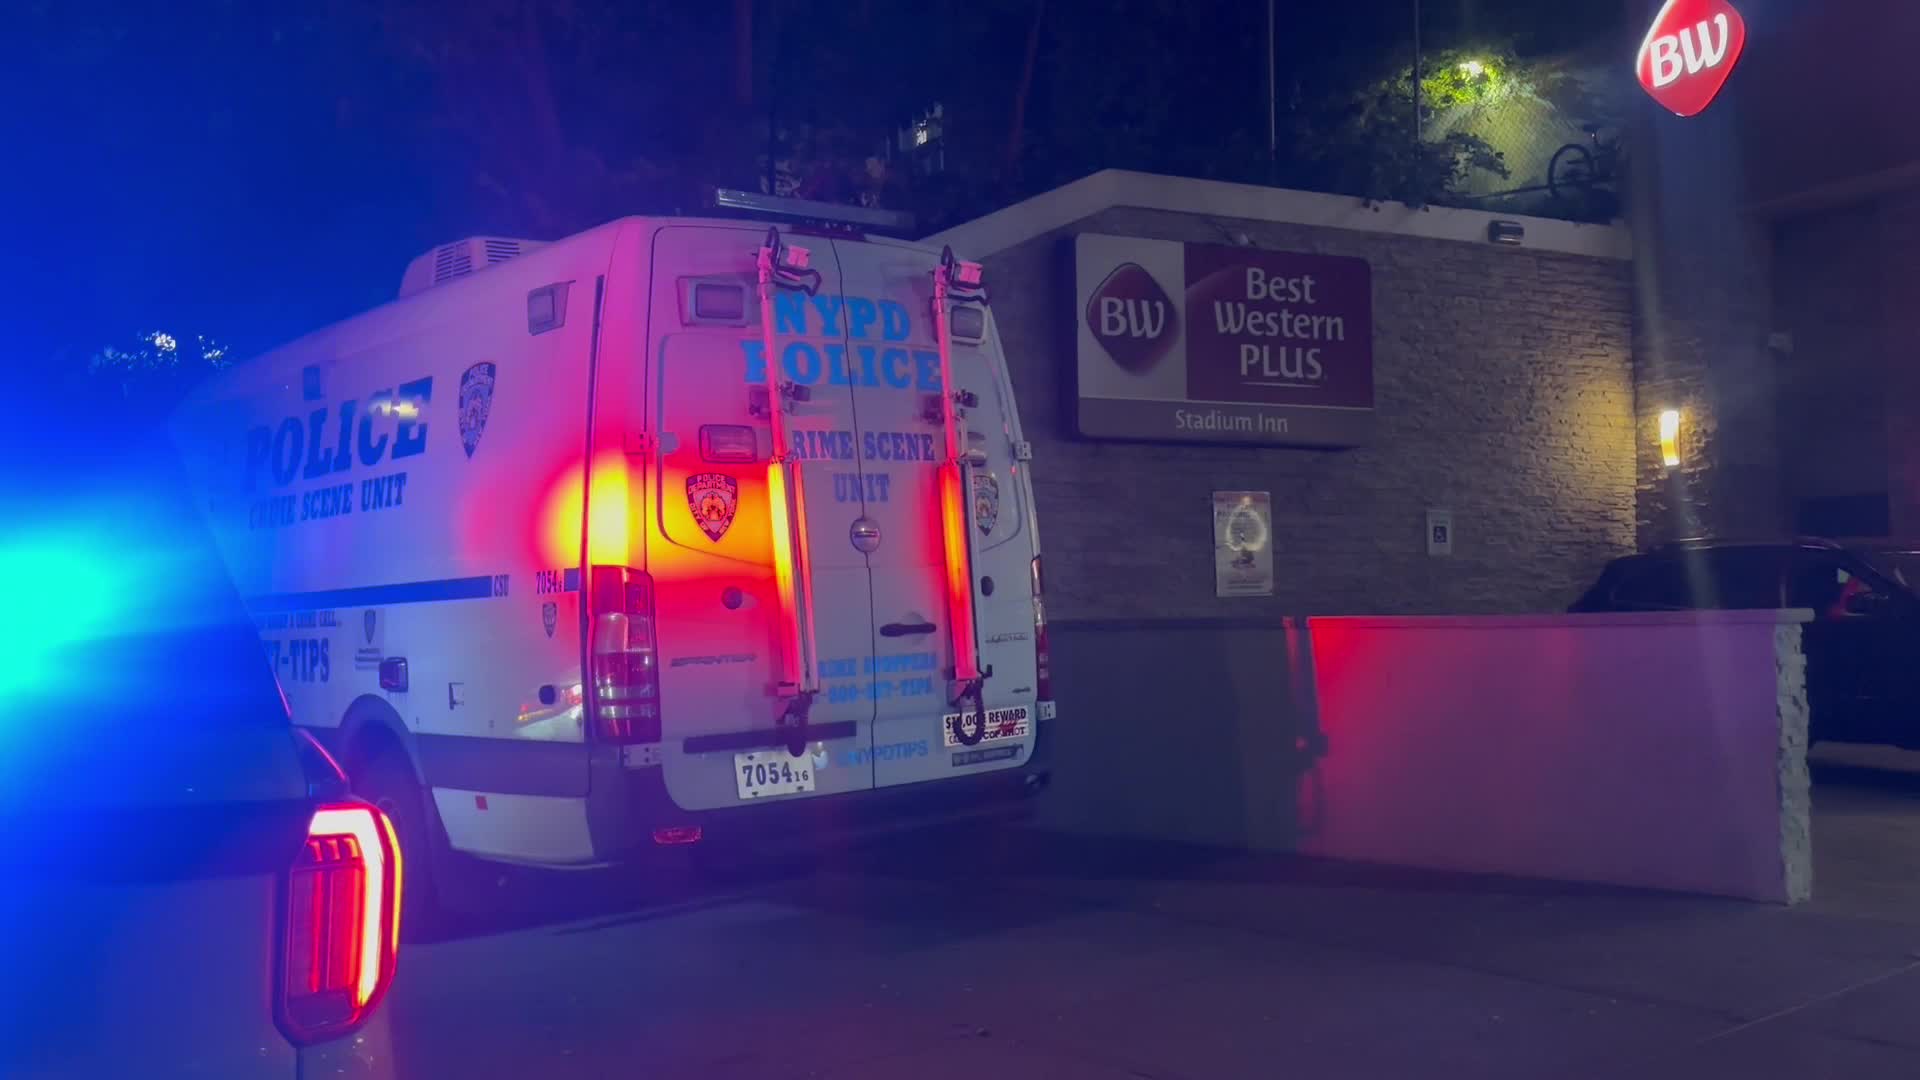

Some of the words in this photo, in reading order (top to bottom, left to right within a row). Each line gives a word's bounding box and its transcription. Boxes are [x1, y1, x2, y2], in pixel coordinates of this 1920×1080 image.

[1650, 13, 1728, 87] BW
[1246, 267, 1316, 304] Best
[776, 293, 910, 341] NYPD
[1100, 296, 1165, 339] BW
[1214, 300, 1345, 341] Western
[1240, 344, 1323, 380] PLUS
[245, 376, 433, 493] POLICE
[1175, 408, 1253, 431] Stadium
[1258, 413, 1289, 433] Inn
[791, 430, 853, 460] RIME
[864, 432, 936, 461] SCENE
[301, 484, 352, 520] SCENE
[361, 472, 407, 512] UNIT
[833, 474, 889, 502] UNIT
[988, 708, 1027, 723] REWARD
[742, 761, 793, 788] 7054
[794, 770, 809, 782] 16
